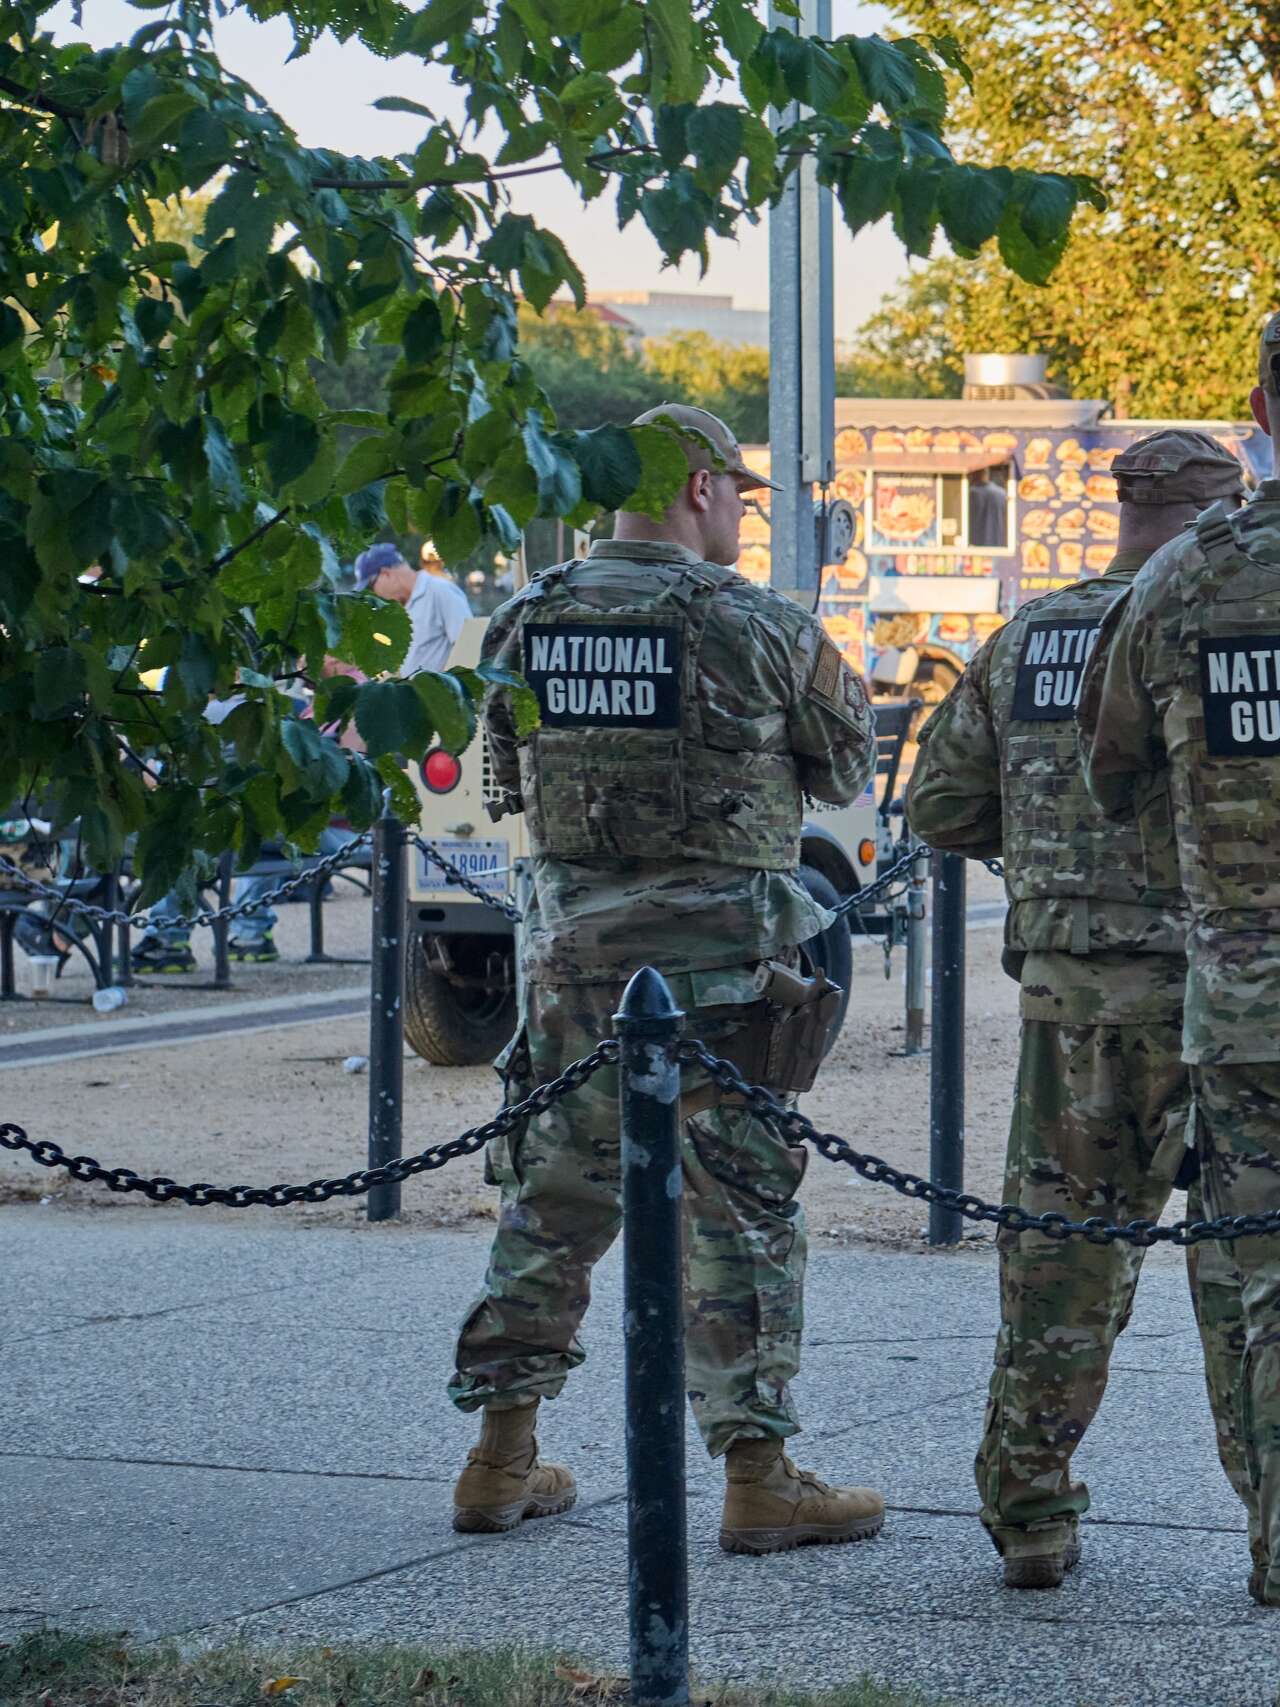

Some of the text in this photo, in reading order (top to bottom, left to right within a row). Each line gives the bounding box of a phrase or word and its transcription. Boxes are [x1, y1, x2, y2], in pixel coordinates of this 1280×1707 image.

[531, 635, 673, 674] NATIONAL
[546, 677, 656, 716] GUARD
[1034, 670, 1081, 707] GU
